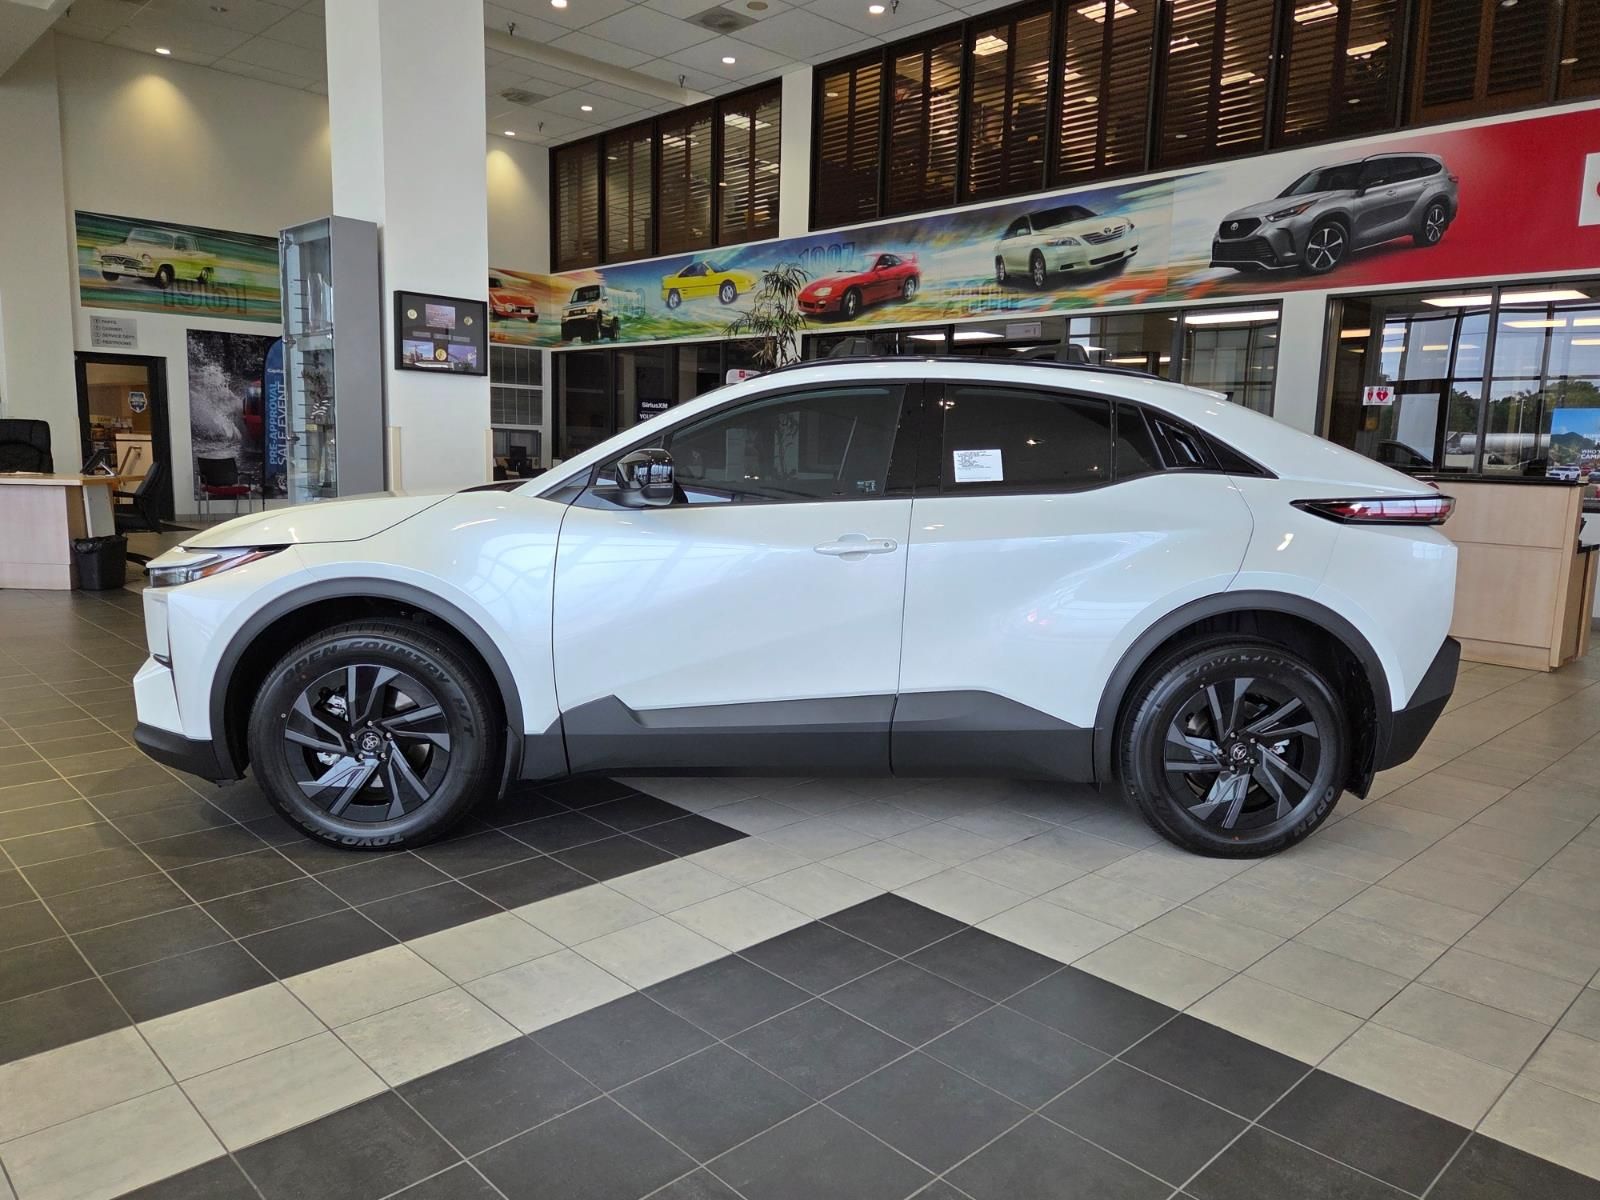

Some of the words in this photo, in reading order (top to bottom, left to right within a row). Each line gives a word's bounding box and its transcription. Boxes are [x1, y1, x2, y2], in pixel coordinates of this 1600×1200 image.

[269, 381, 279, 466] PRE-APPROVAL
[349, 640, 451, 684] COUNTRY
[1293, 785, 1335, 837] OPEN
